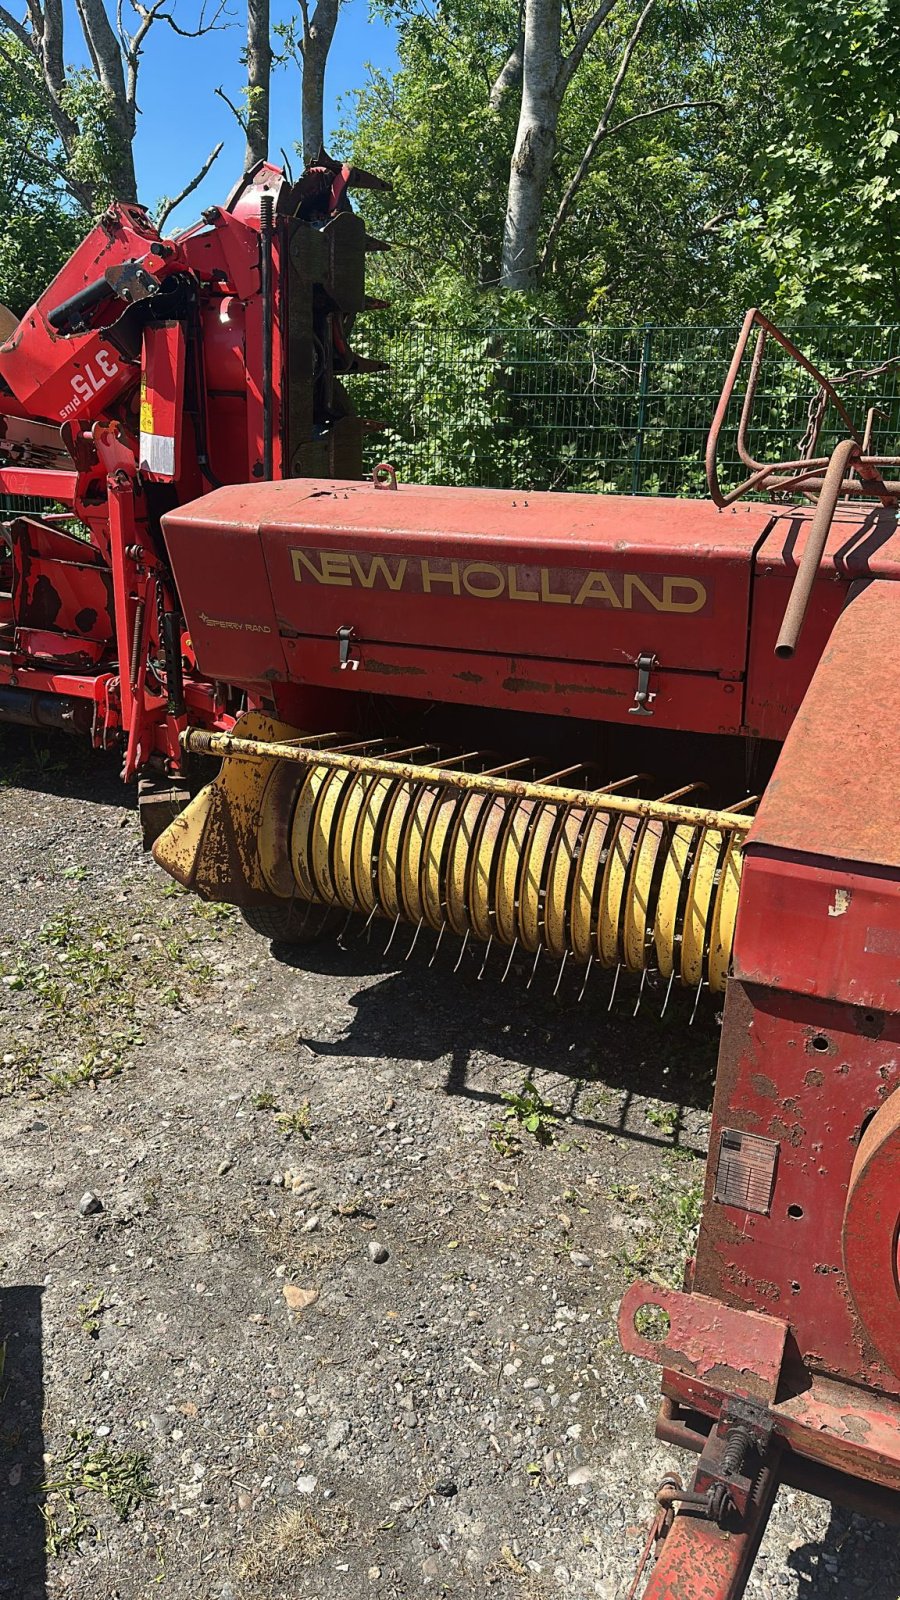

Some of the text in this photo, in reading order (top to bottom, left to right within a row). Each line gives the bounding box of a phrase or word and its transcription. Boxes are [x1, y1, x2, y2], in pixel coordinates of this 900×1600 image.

[59, 349, 119, 419] 375 plus
[291, 549, 707, 613] NEW HOLLAND
[206, 619, 271, 633] SPERRY RAND
